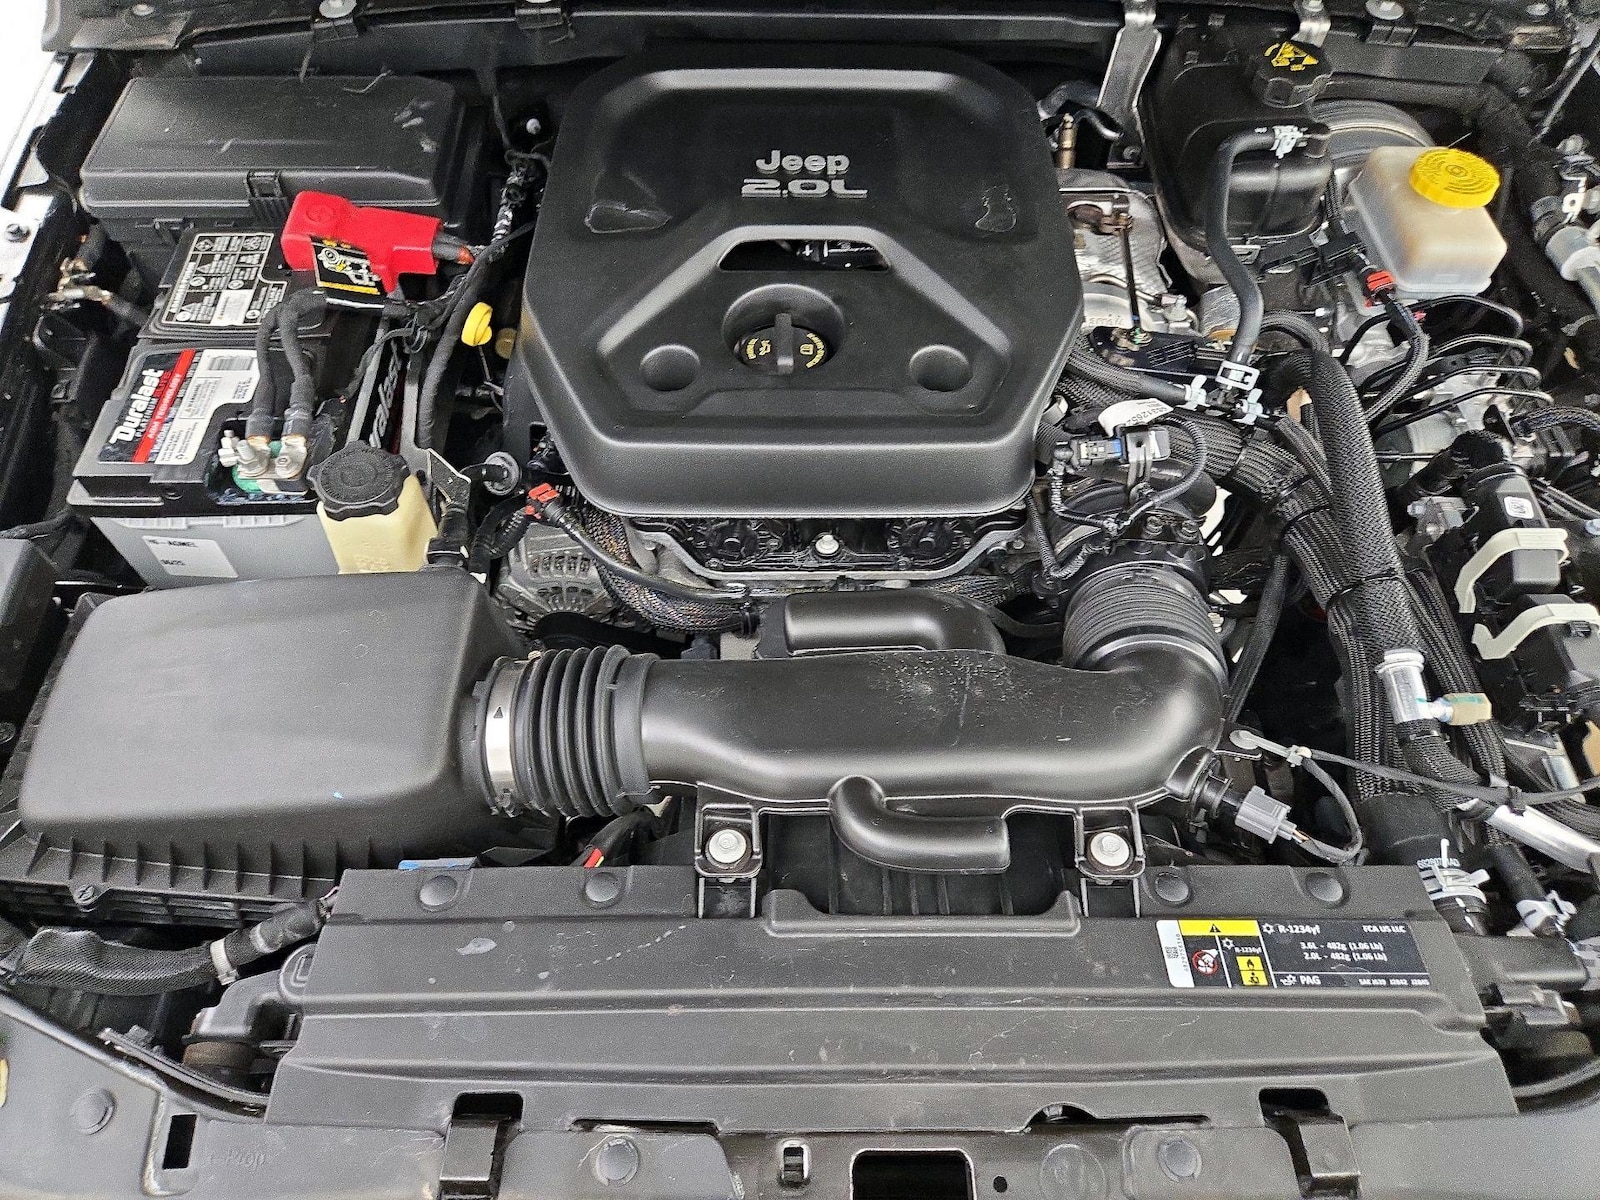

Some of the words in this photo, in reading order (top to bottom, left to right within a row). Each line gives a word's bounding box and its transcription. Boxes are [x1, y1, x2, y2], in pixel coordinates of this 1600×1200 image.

[755, 150, 850, 176] Jeep
[741, 178, 868, 198] 2.0L
[109, 369, 164, 444] Duralast
[147, 421, 161, 439] AGM
[155, 374, 182, 419] TECHNOLOGY
[135, 398, 159, 439] PLATINUM
[1278, 925, 1320, 935] R-1234yf
[1362, 925, 1379, 933] FCA
[1379, 925, 1391, 933] US
[1391, 925, 1406, 933] LLC
[1300, 942, 1318, 950] 3.6L
[1326, 942, 1347, 951] 482g
[1348, 942, 1369, 951] (1.06
[1369, 942, 1384, 952] Lb)
[1303, 952, 1322, 960] 2.0L
[1330, 952, 1351, 962] 482g
[1352, 952, 1373, 962] (1.06
[1373, 952, 1388, 962] Lb)
[1299, 975, 1321, 985] PAG
